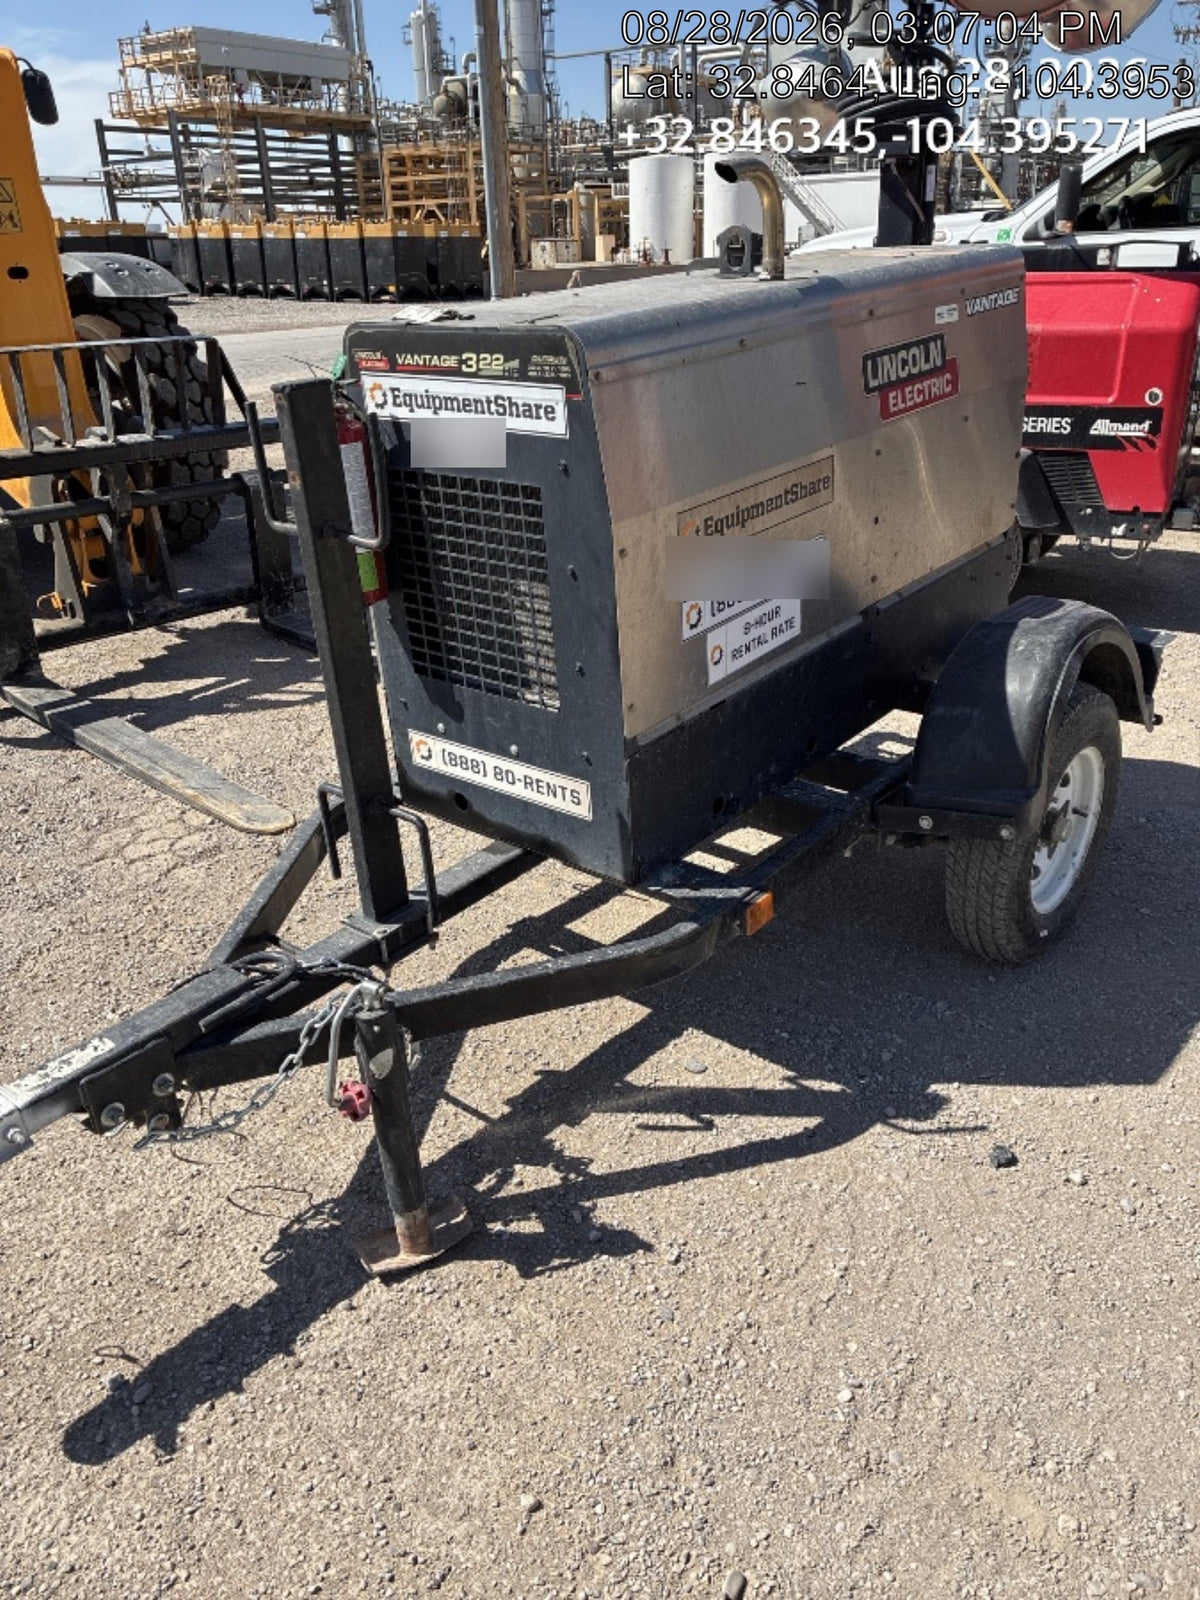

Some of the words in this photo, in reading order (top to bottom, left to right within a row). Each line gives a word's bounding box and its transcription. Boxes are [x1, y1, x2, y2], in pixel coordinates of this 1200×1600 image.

[966, 288, 1020, 316] VANTAGE
[396, 353, 459, 367] VANTAGE
[461, 353, 504, 372] 322
[867, 340, 942, 388] LINCOLN
[389, 387, 557, 422] EquipmentShare
[889, 373, 952, 412] ELECTRIC
[1090, 418, 1152, 435] Allmand
[703, 473, 831, 537] EquipmentShare
[731, 632, 769, 662] RENTAL
[771, 616, 796, 641] RATE
[441, 748, 488, 778] (888)
[493, 765, 582, 806] 80-RENTS
